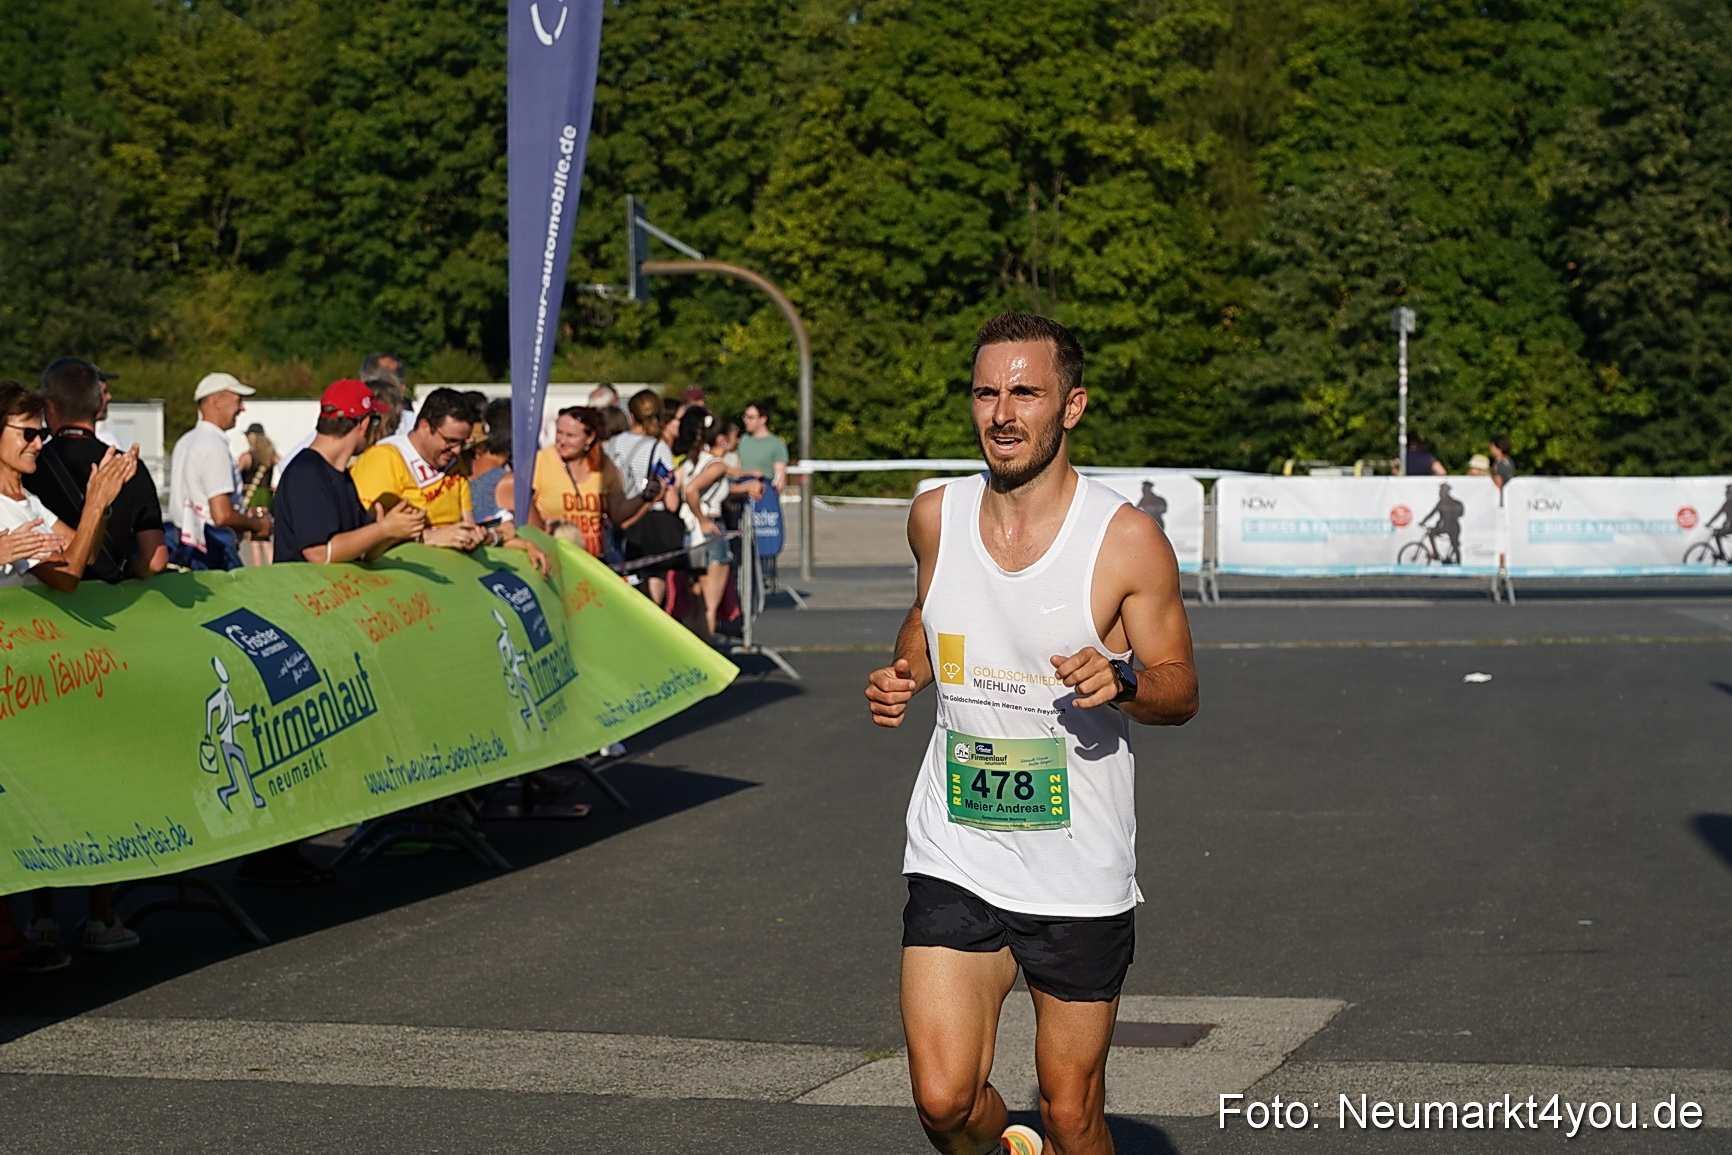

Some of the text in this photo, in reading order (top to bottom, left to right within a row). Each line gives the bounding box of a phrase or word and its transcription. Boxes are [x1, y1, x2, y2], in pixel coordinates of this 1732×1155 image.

[48, 646, 129, 699] länger.
[973, 666, 1063, 686] GOLDSCHMIEDE
[973, 678, 1026, 695] MIEHLING
[251, 652, 377, 769] firmenlauf
[949, 694, 991, 707] Goldschmiede
[1002, 702, 1023, 711] Herzen
[1024, 705, 1036, 713] von
[268, 748, 328, 797] neumarkt
[970, 753, 1008, 762] Firmenlauf
[952, 774, 962, 806] RUN
[971, 769, 1035, 800] 478
[1049, 774, 1063, 815] 2022
[965, 798, 1046, 814] Meier Andreas
